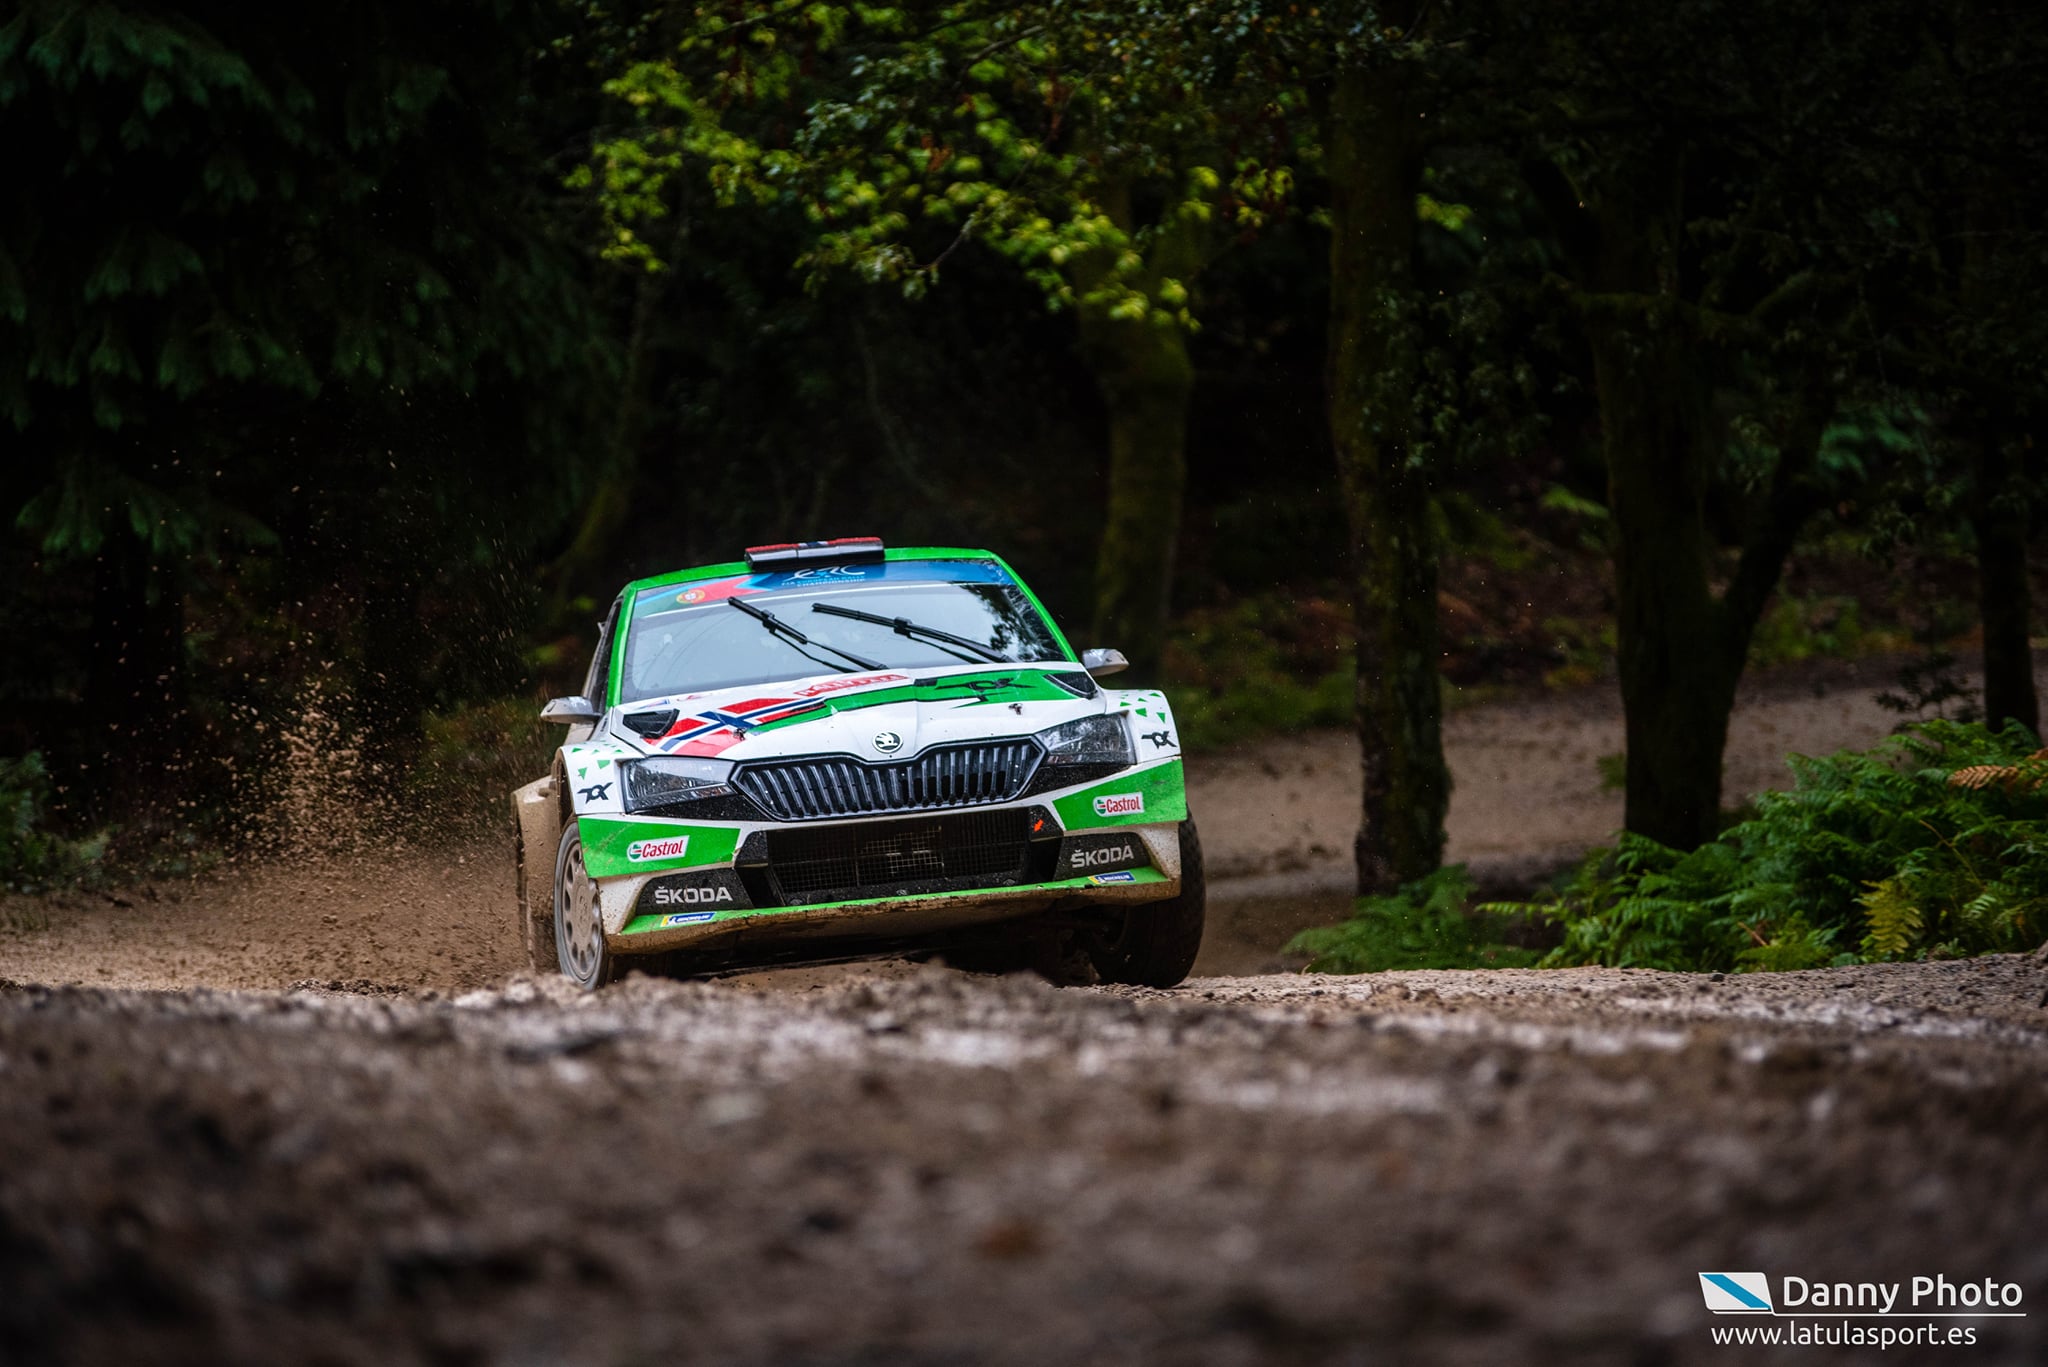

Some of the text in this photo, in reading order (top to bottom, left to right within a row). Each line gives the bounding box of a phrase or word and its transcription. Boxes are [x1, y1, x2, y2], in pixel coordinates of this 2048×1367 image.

[1106, 797, 1141, 813] Castrol
[642, 840, 683, 858] Castrol
[1070, 844, 1135, 869] ŠKODA
[654, 886, 733, 905] ŠKODA
